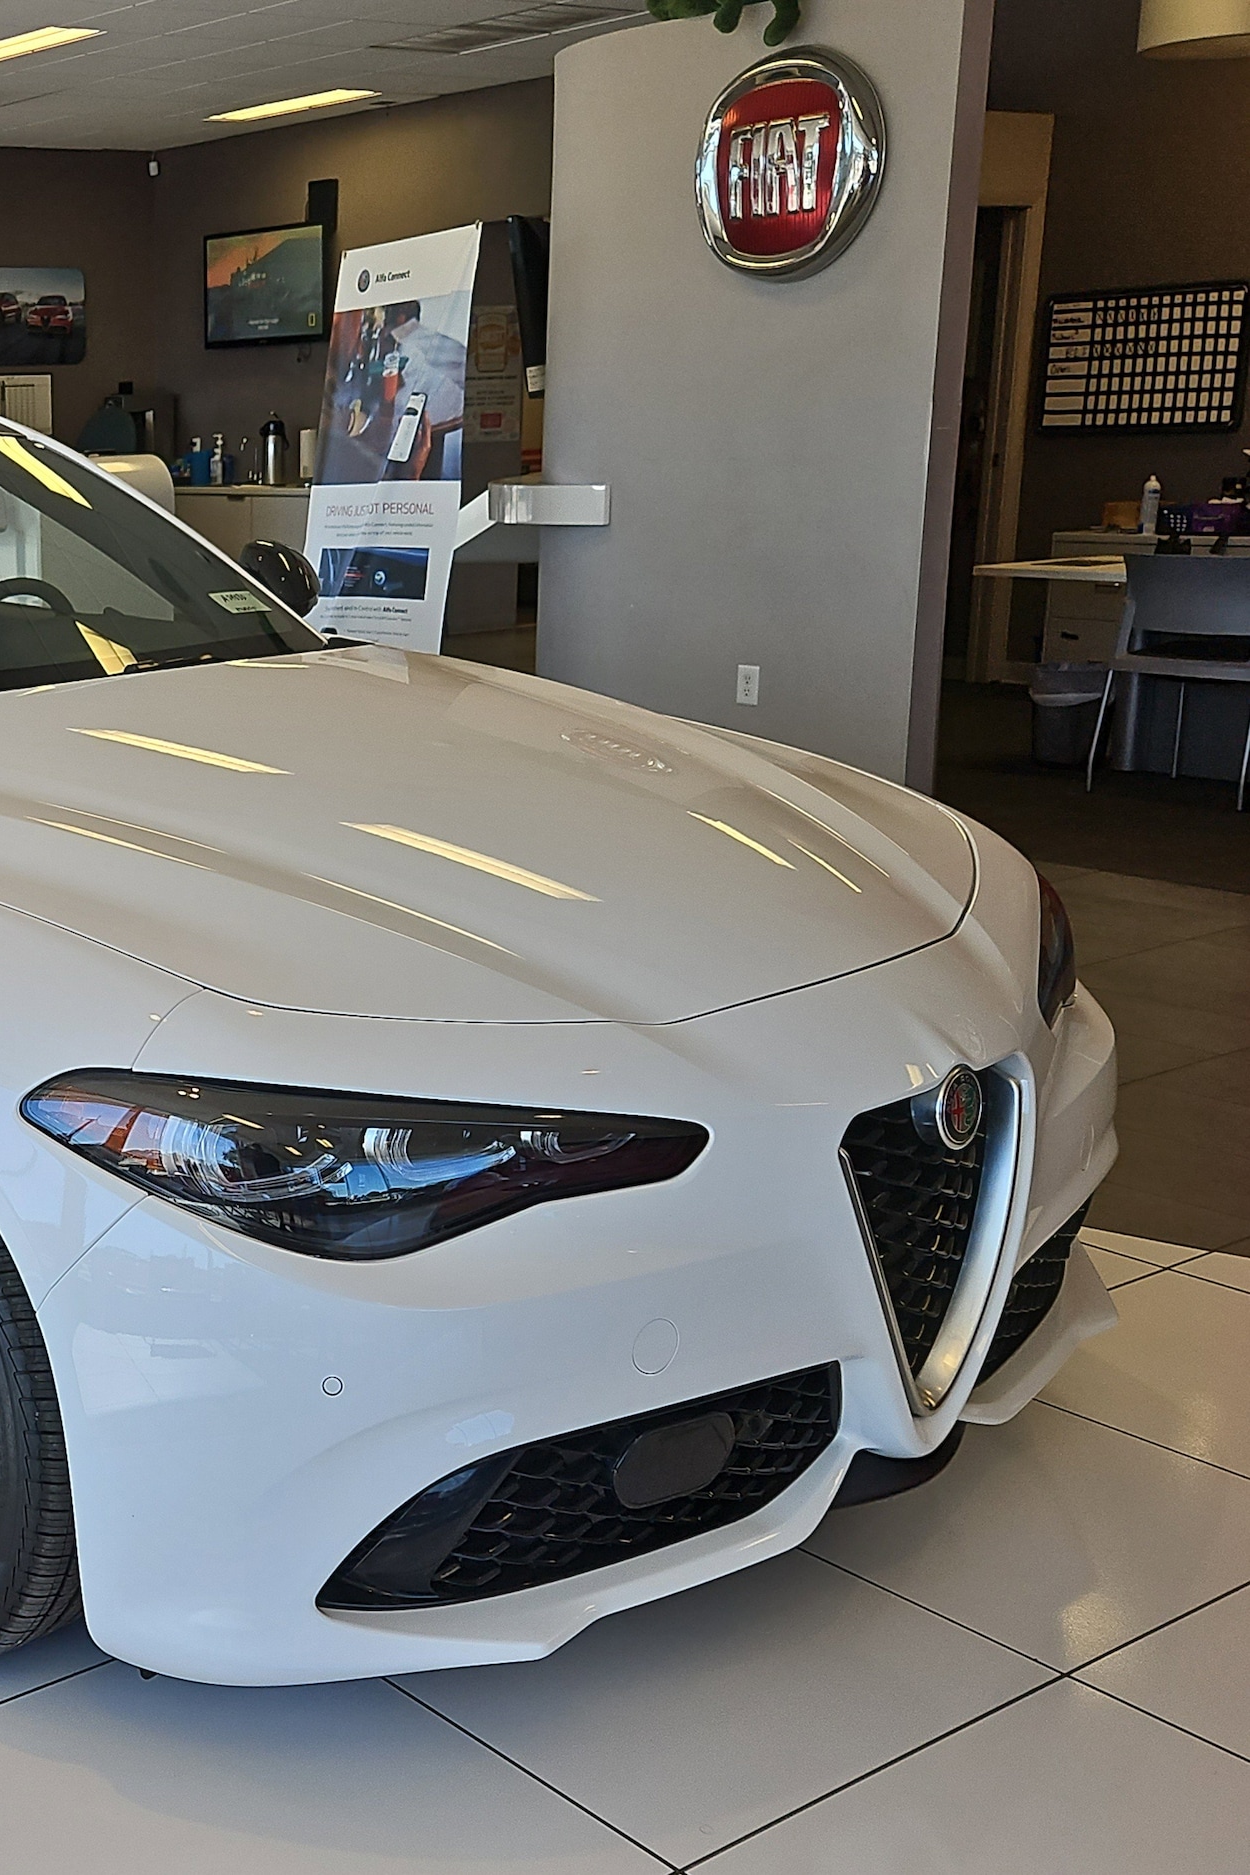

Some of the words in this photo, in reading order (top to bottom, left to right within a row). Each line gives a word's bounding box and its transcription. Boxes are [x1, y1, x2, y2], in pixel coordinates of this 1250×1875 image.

[727, 114, 831, 220] FIAT
[388, 270, 410, 281] Connect
[326, 505, 353, 517] DRIVING
[382, 502, 434, 515] PERSONAL
